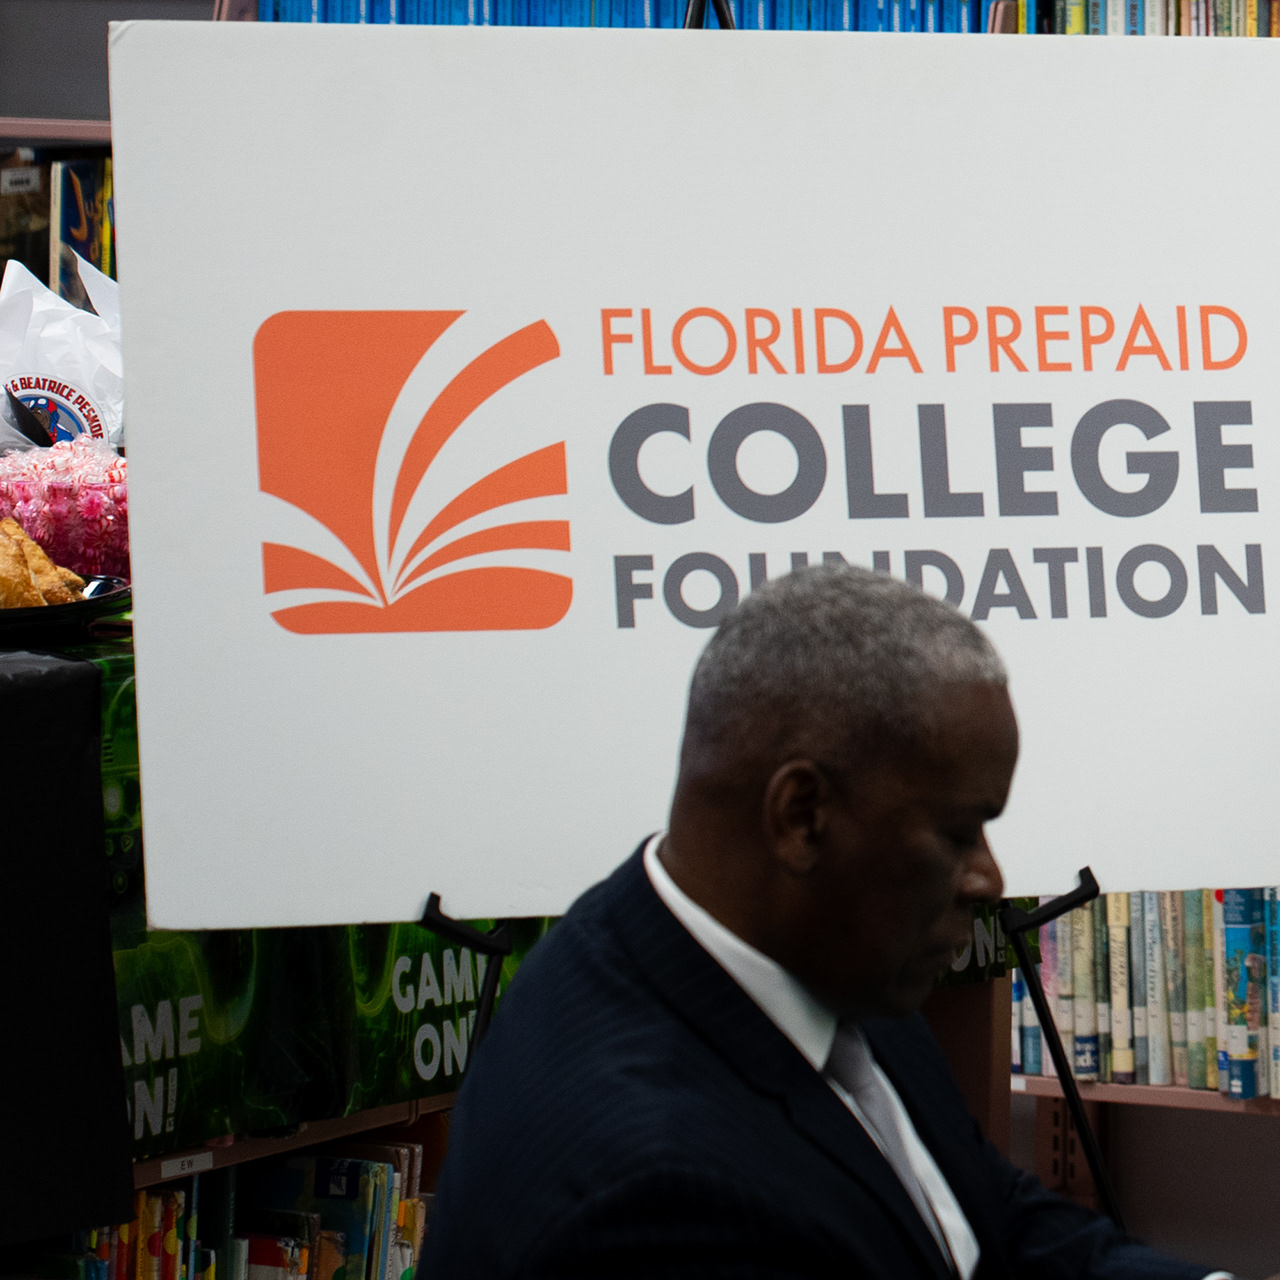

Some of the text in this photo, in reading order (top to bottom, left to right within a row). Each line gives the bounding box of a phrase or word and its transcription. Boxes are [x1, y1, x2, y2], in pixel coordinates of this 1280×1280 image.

[602, 303, 1249, 378] FLORIDA PREPAID
[19, 376, 76, 402] BEATRICE
[72, 394, 104, 440] PESKOE
[607, 398, 1260, 525] COLLEGE
[120, 994, 204, 1067] ME
[127, 1067, 178, 1140] N!
[180, 1158, 195, 1172] EW
